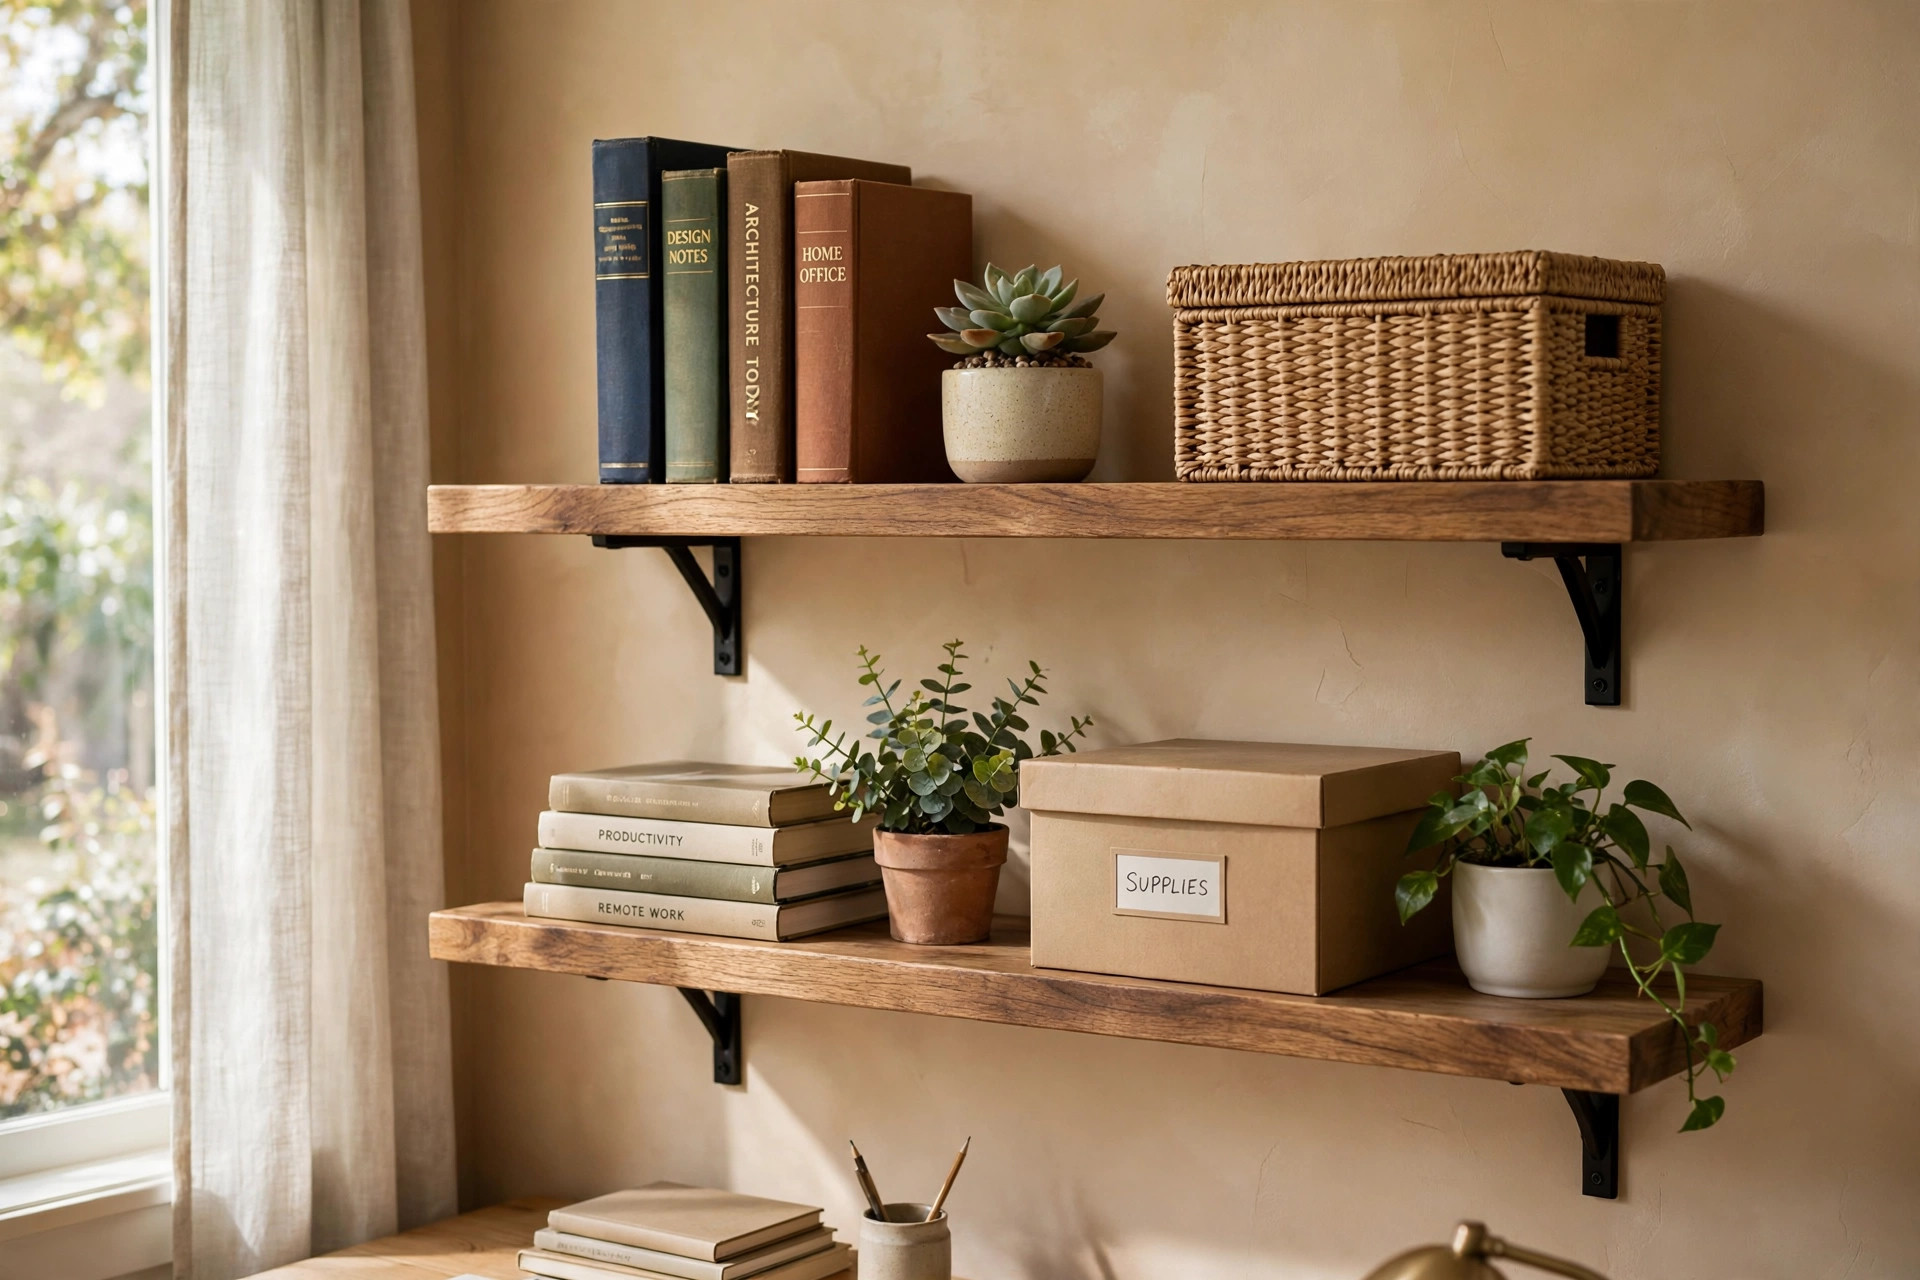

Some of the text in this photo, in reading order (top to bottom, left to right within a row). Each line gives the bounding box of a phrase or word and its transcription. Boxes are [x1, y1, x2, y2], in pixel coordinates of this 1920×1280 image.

[667, 229, 711, 245] DESIGN
[669, 249, 708, 264] NOTES
[802, 246, 843, 262] HOME
[745, 202, 759, 347] ARCHITECTURE
[799, 266, 847, 284] OFFICE
[598, 828, 683, 847] PRODUCTIVITY
[1126, 871, 1208, 897] SUPPLIES
[598, 902, 685, 921] REMOTE WORK
